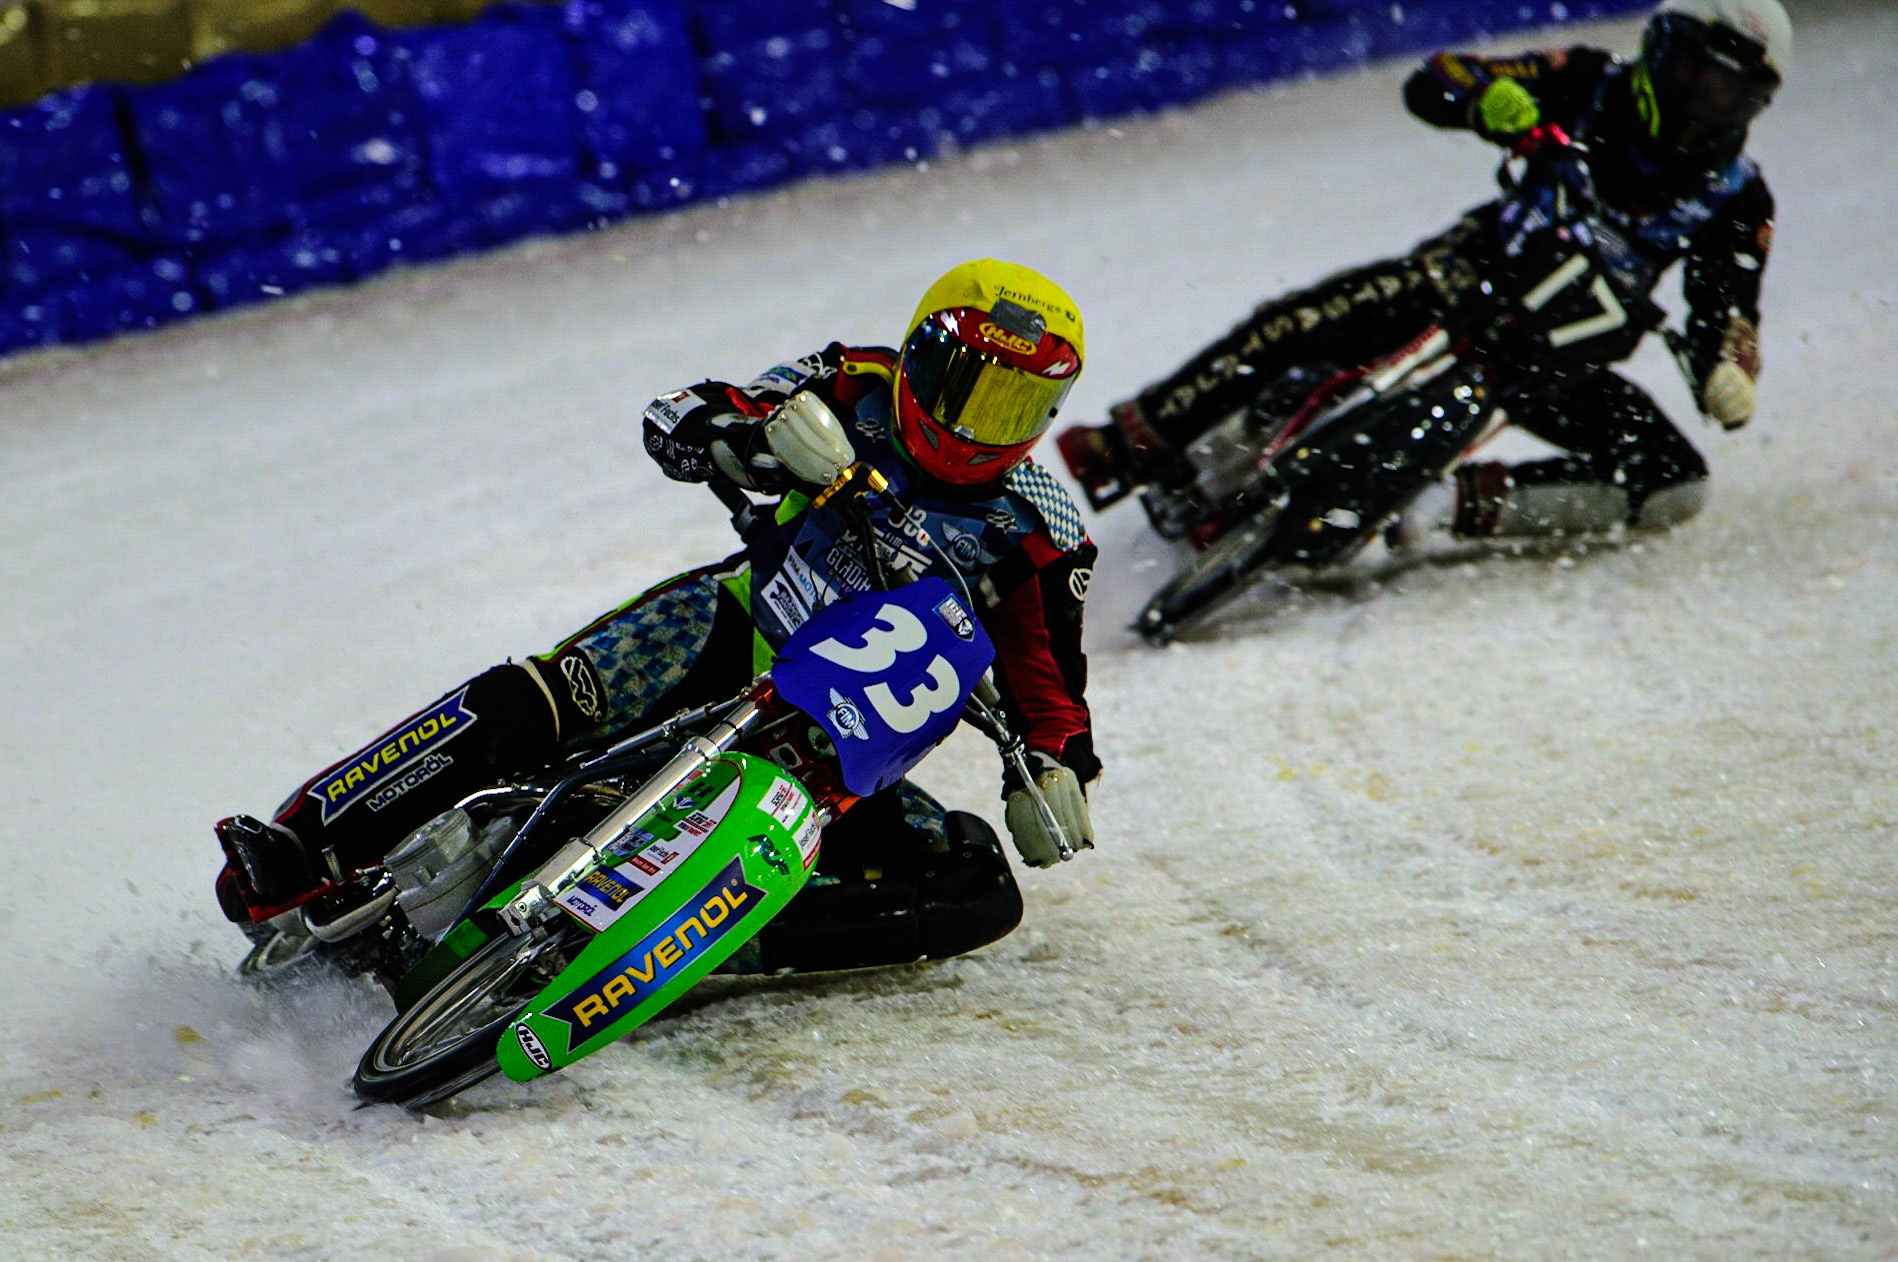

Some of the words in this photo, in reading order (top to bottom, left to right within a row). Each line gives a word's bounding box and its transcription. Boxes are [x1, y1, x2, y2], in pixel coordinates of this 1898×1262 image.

[1522, 254, 1627, 347] 17
[809, 603, 960, 734] 33
[838, 704, 862, 728] FIM
[327, 709, 457, 802] RAVENOL
[368, 753, 452, 811] MOTORÖL
[587, 870, 629, 904] RAVENOL
[518, 1025, 550, 1070] HJC
